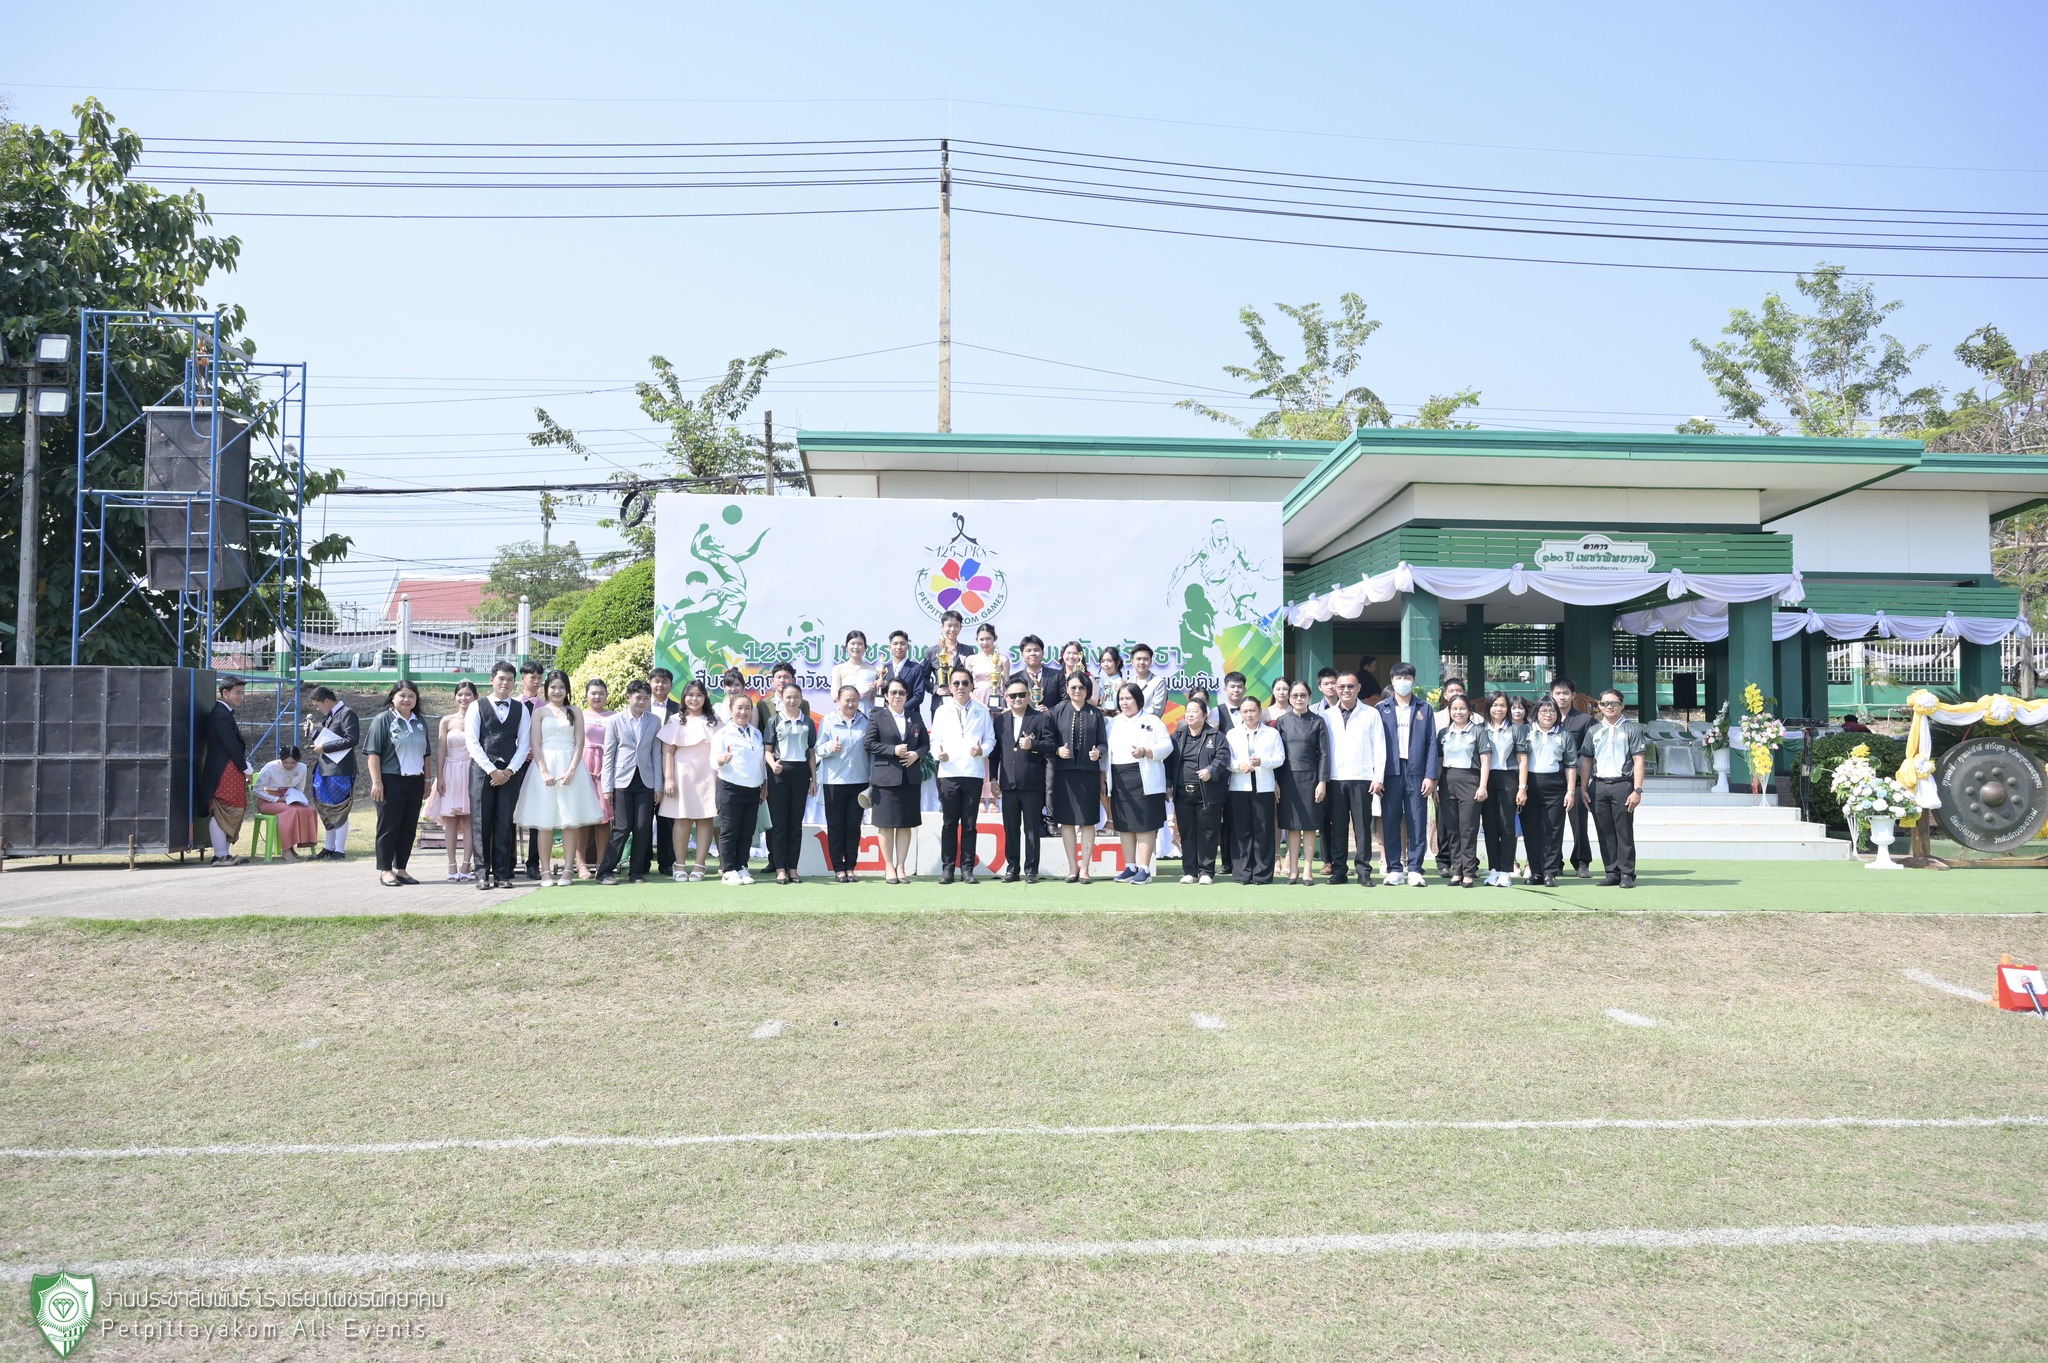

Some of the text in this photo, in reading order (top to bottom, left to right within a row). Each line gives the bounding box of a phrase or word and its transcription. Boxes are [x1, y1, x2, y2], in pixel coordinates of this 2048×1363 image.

[1542, 551, 1649, 564] ๑๒๐ ปี เพชรพิทยาคม
[918, 591, 1004, 625] PETPITTOM GAMES
[743, 641, 793, 663] 125
[803, 635, 823, 663] ปี
